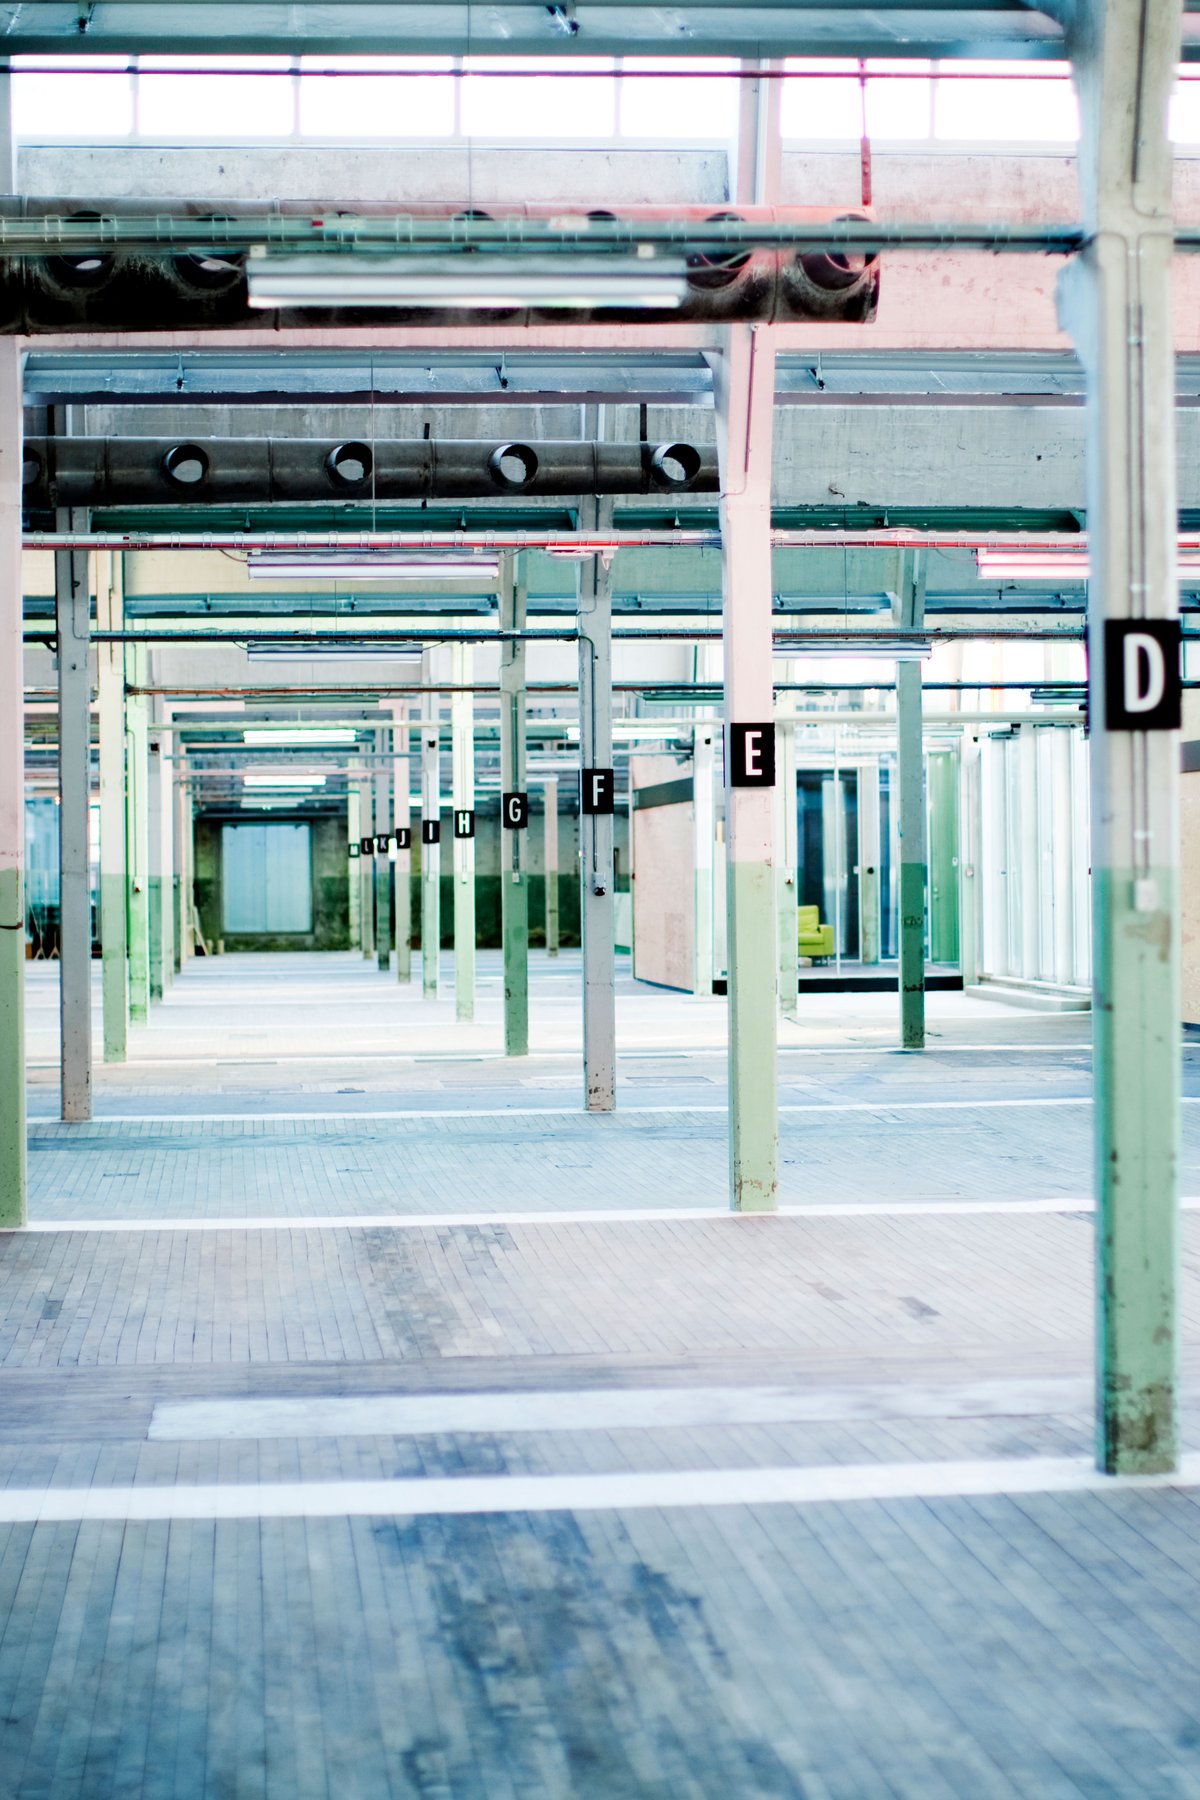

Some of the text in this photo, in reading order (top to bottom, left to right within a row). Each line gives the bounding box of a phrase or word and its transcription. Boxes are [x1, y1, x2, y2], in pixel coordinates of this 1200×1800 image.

[1123, 633, 1165, 713] D
[745, 731, 763, 776] E
[592, 775, 605, 807] F
[508, 797, 522, 822] G
[458, 812, 470, 834] H
[380, 837, 387, 849] K
[399, 830, 406, 846] J
